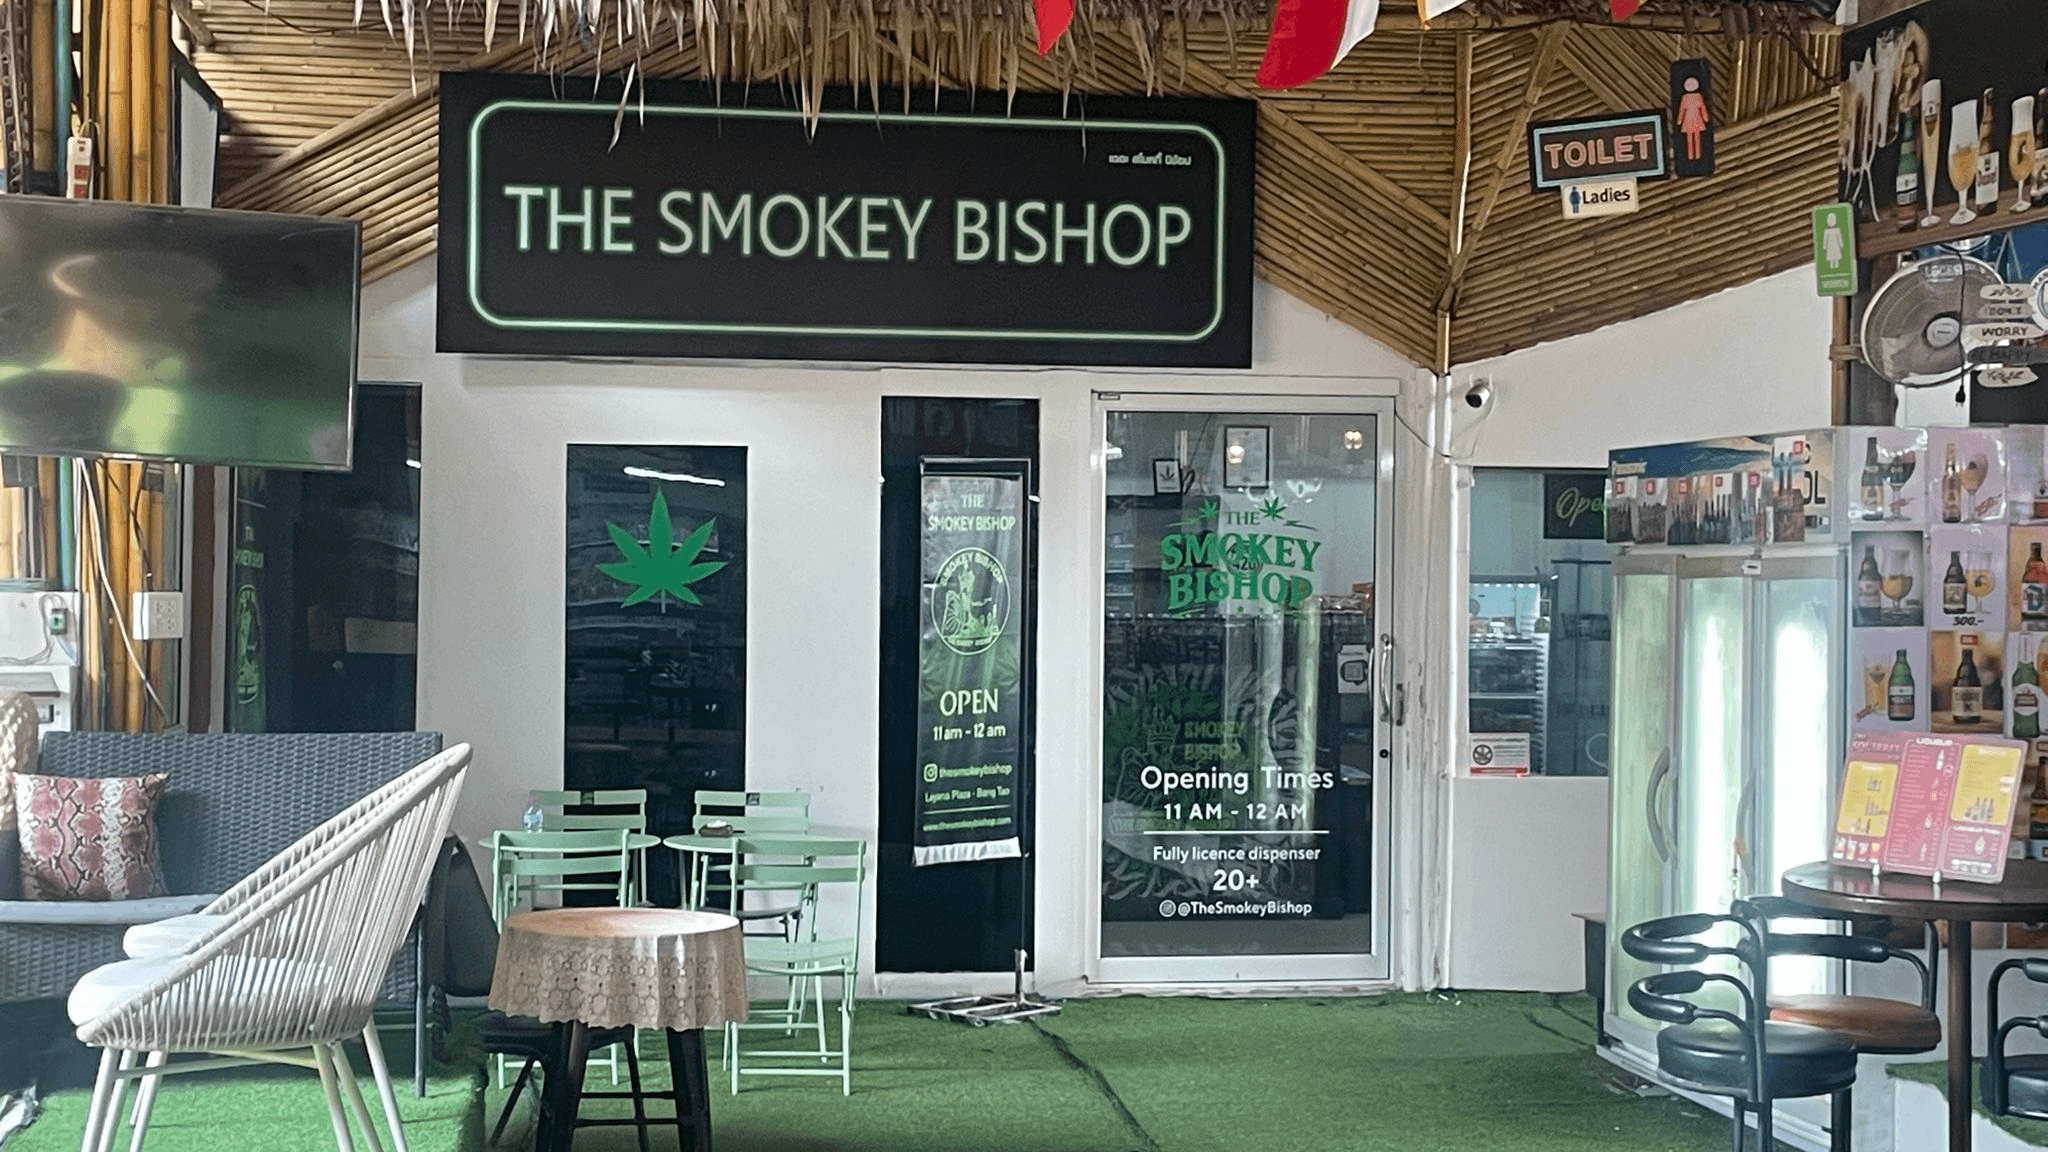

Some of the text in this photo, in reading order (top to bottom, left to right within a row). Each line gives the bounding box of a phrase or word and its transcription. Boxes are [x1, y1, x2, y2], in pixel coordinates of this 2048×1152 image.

[1544, 133, 1653, 169] TOILET
[1582, 187, 1631, 205] Ladies
[504, 184, 1192, 267] THE SMOKEY BISHOP
[1981, 326, 2028, 337] WORRY
[960, 494, 985, 508] THE
[1556, 487, 1606, 528] Ope
[928, 515, 1016, 531] SMOKEY BISHOP
[1225, 510, 1261, 526] THE
[1161, 532, 1322, 573] SMOKEY
[940, 552, 974, 587] SMOKEY
[1168, 570, 1313, 609] BISHOP
[939, 688, 999, 716] OPEN
[1184, 720, 1245, 739] SMOKEY
[1184, 743, 1241, 761] BISHOP
[1140, 766, 1334, 795] Opening Times
[1164, 803, 1182, 820] 11
[1189, 803, 1222, 820] AM
[1247, 803, 1266, 820] 12
[1274, 803, 1307, 820] AM
[1153, 846, 1321, 864] Fully licence dispenser
[1212, 869, 1260, 891] 20+
[1177, 900, 1313, 917] @TheSmokeyBishop
